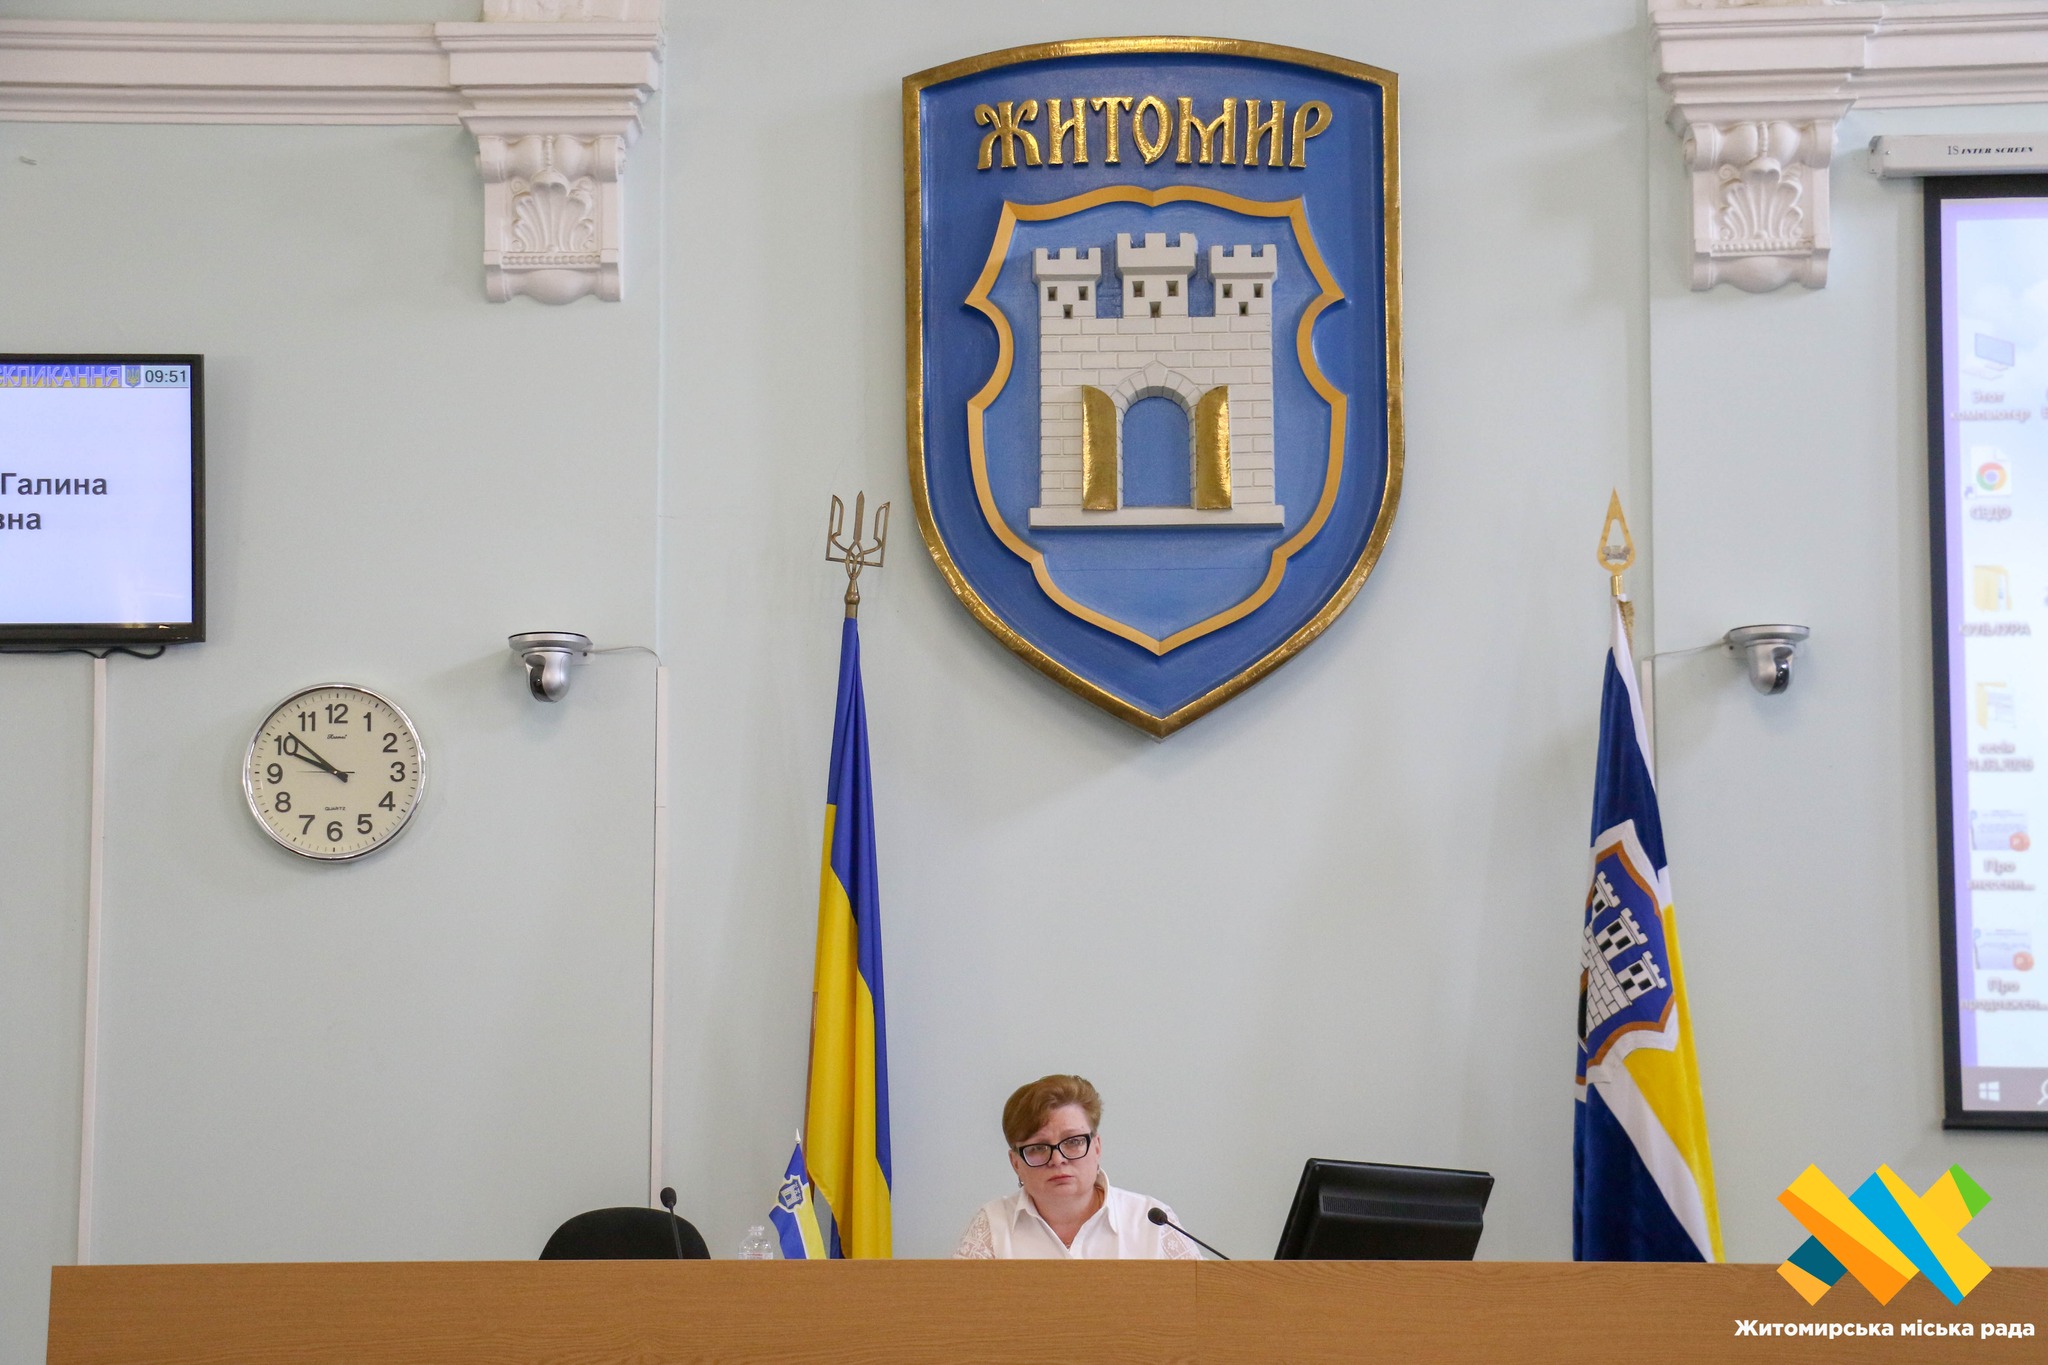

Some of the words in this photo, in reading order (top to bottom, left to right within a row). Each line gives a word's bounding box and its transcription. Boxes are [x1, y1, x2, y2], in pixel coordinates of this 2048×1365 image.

[974, 95, 1333, 170] ЖИТОМИР
[145, 370, 186, 383] 09:51
[1, 473, 108, 495] Галина
[298, 711, 316, 731] 11
[325, 703, 348, 724] 12
[363, 712, 372, 732] 1
[274, 735, 298, 756] 10
[382, 733, 398, 753] 2
[267, 763, 283, 784] 9
[390, 761, 405, 782] 3
[275, 792, 291, 812] 8
[378, 791, 396, 811] 4
[299, 815, 315, 835] 7
[326, 821, 343, 842] 6
[357, 814, 373, 834] 5
